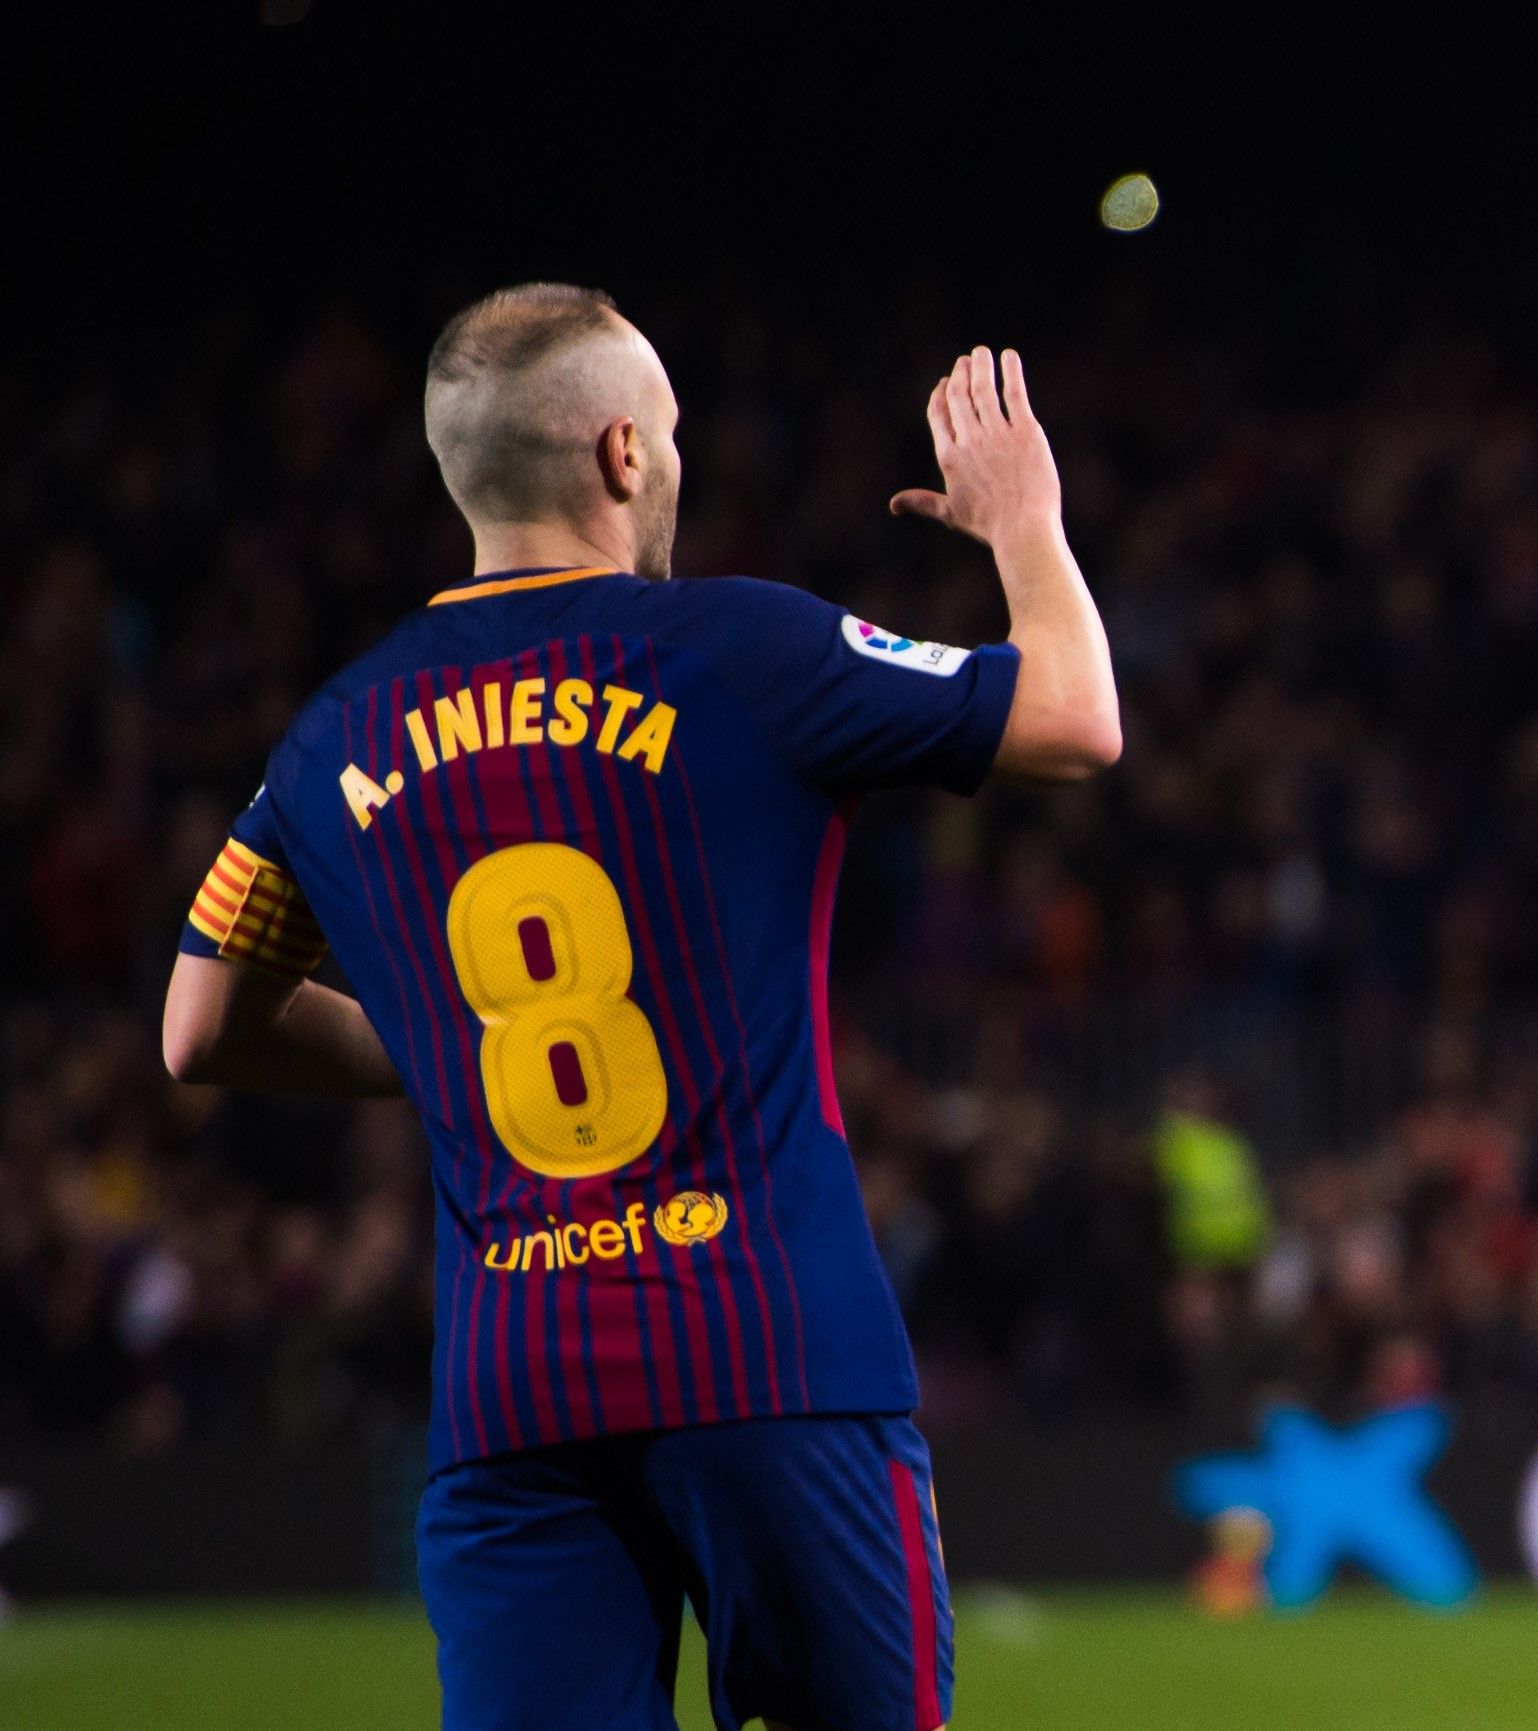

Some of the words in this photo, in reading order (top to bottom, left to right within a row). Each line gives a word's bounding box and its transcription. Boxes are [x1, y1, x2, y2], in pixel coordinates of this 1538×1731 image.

[339, 762, 404, 831] A.
[405, 678, 677, 775] INIESTA
[447, 843, 668, 1178] 8
[484, 1202, 646, 1272] unicef
